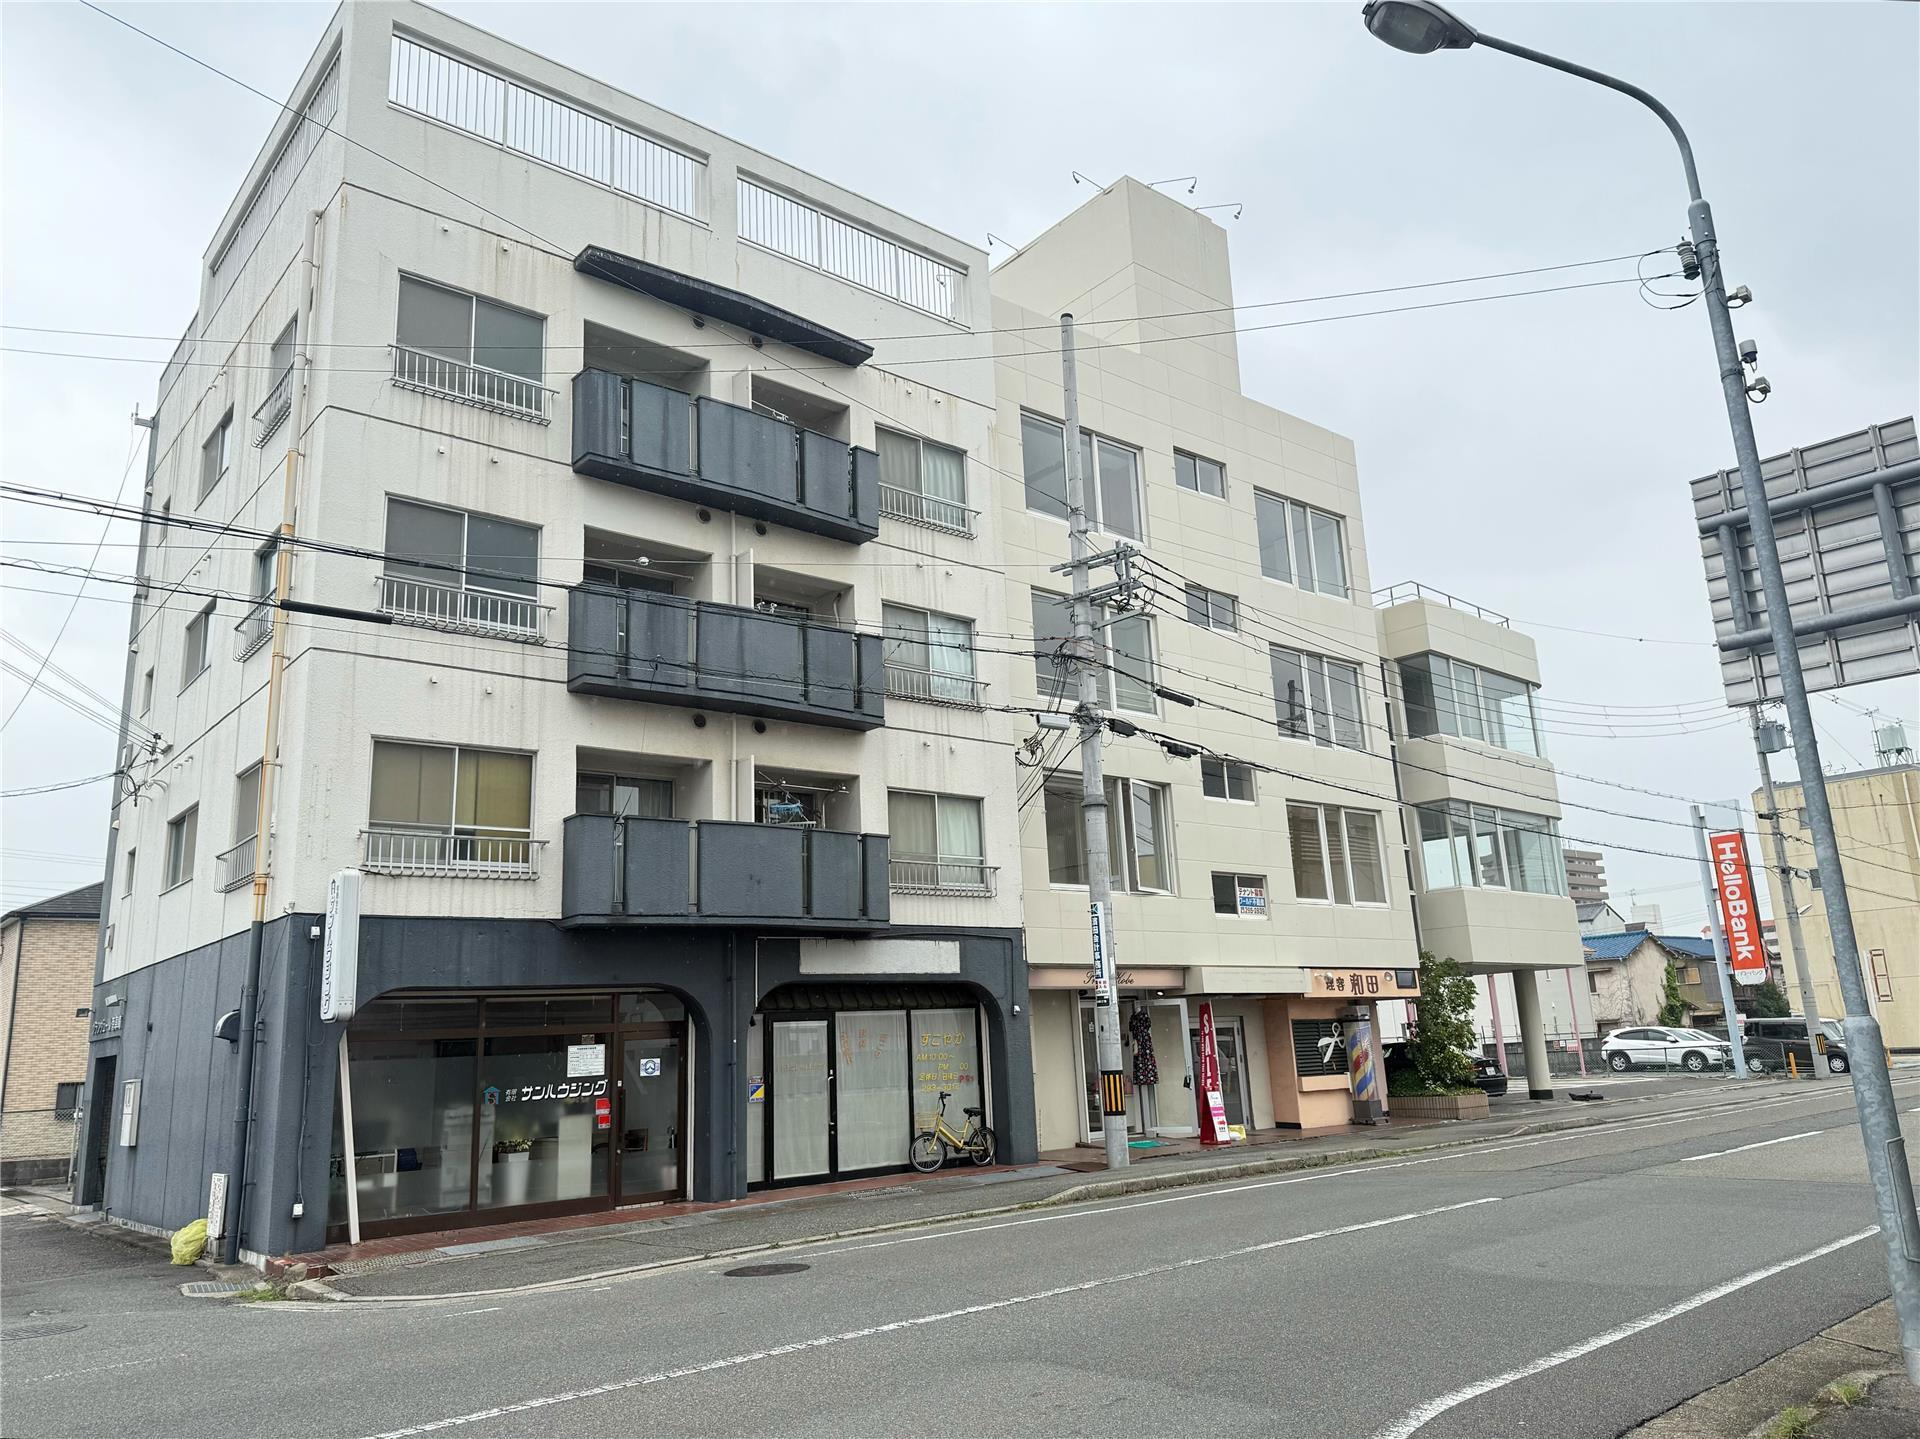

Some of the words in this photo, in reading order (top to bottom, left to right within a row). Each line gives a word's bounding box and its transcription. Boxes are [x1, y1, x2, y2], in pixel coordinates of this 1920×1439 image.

[1717, 841, 1756, 961] HelloBank
[920, 1031, 966, 1047] すこやか
[521, 1078, 609, 1102] サンハウジング
